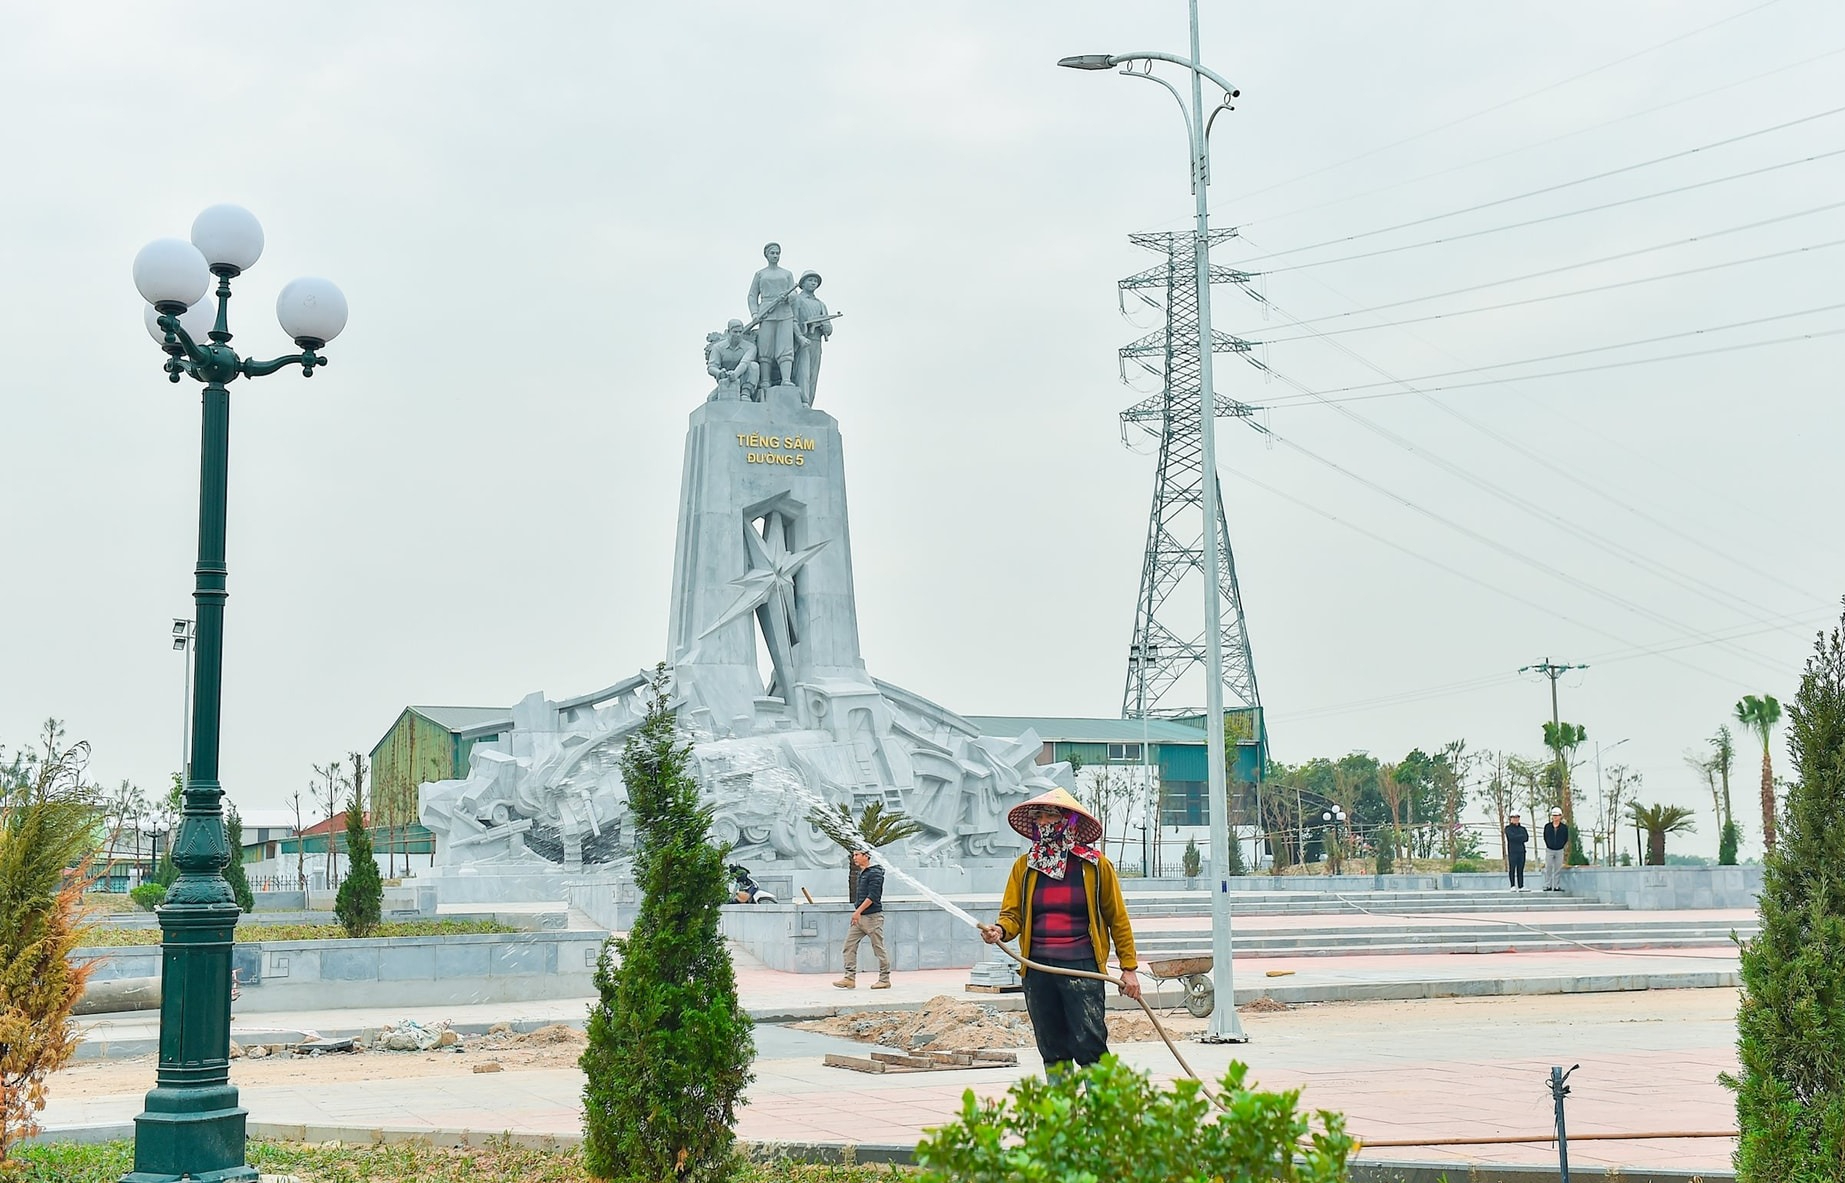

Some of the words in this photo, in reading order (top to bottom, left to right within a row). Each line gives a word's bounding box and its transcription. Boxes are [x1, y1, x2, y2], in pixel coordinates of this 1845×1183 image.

[737, 431, 780, 449] TIẾNG
[783, 433, 815, 450] SẤM
[747, 451, 793, 465] ĐƯỜNG
[795, 454, 804, 466] 5
